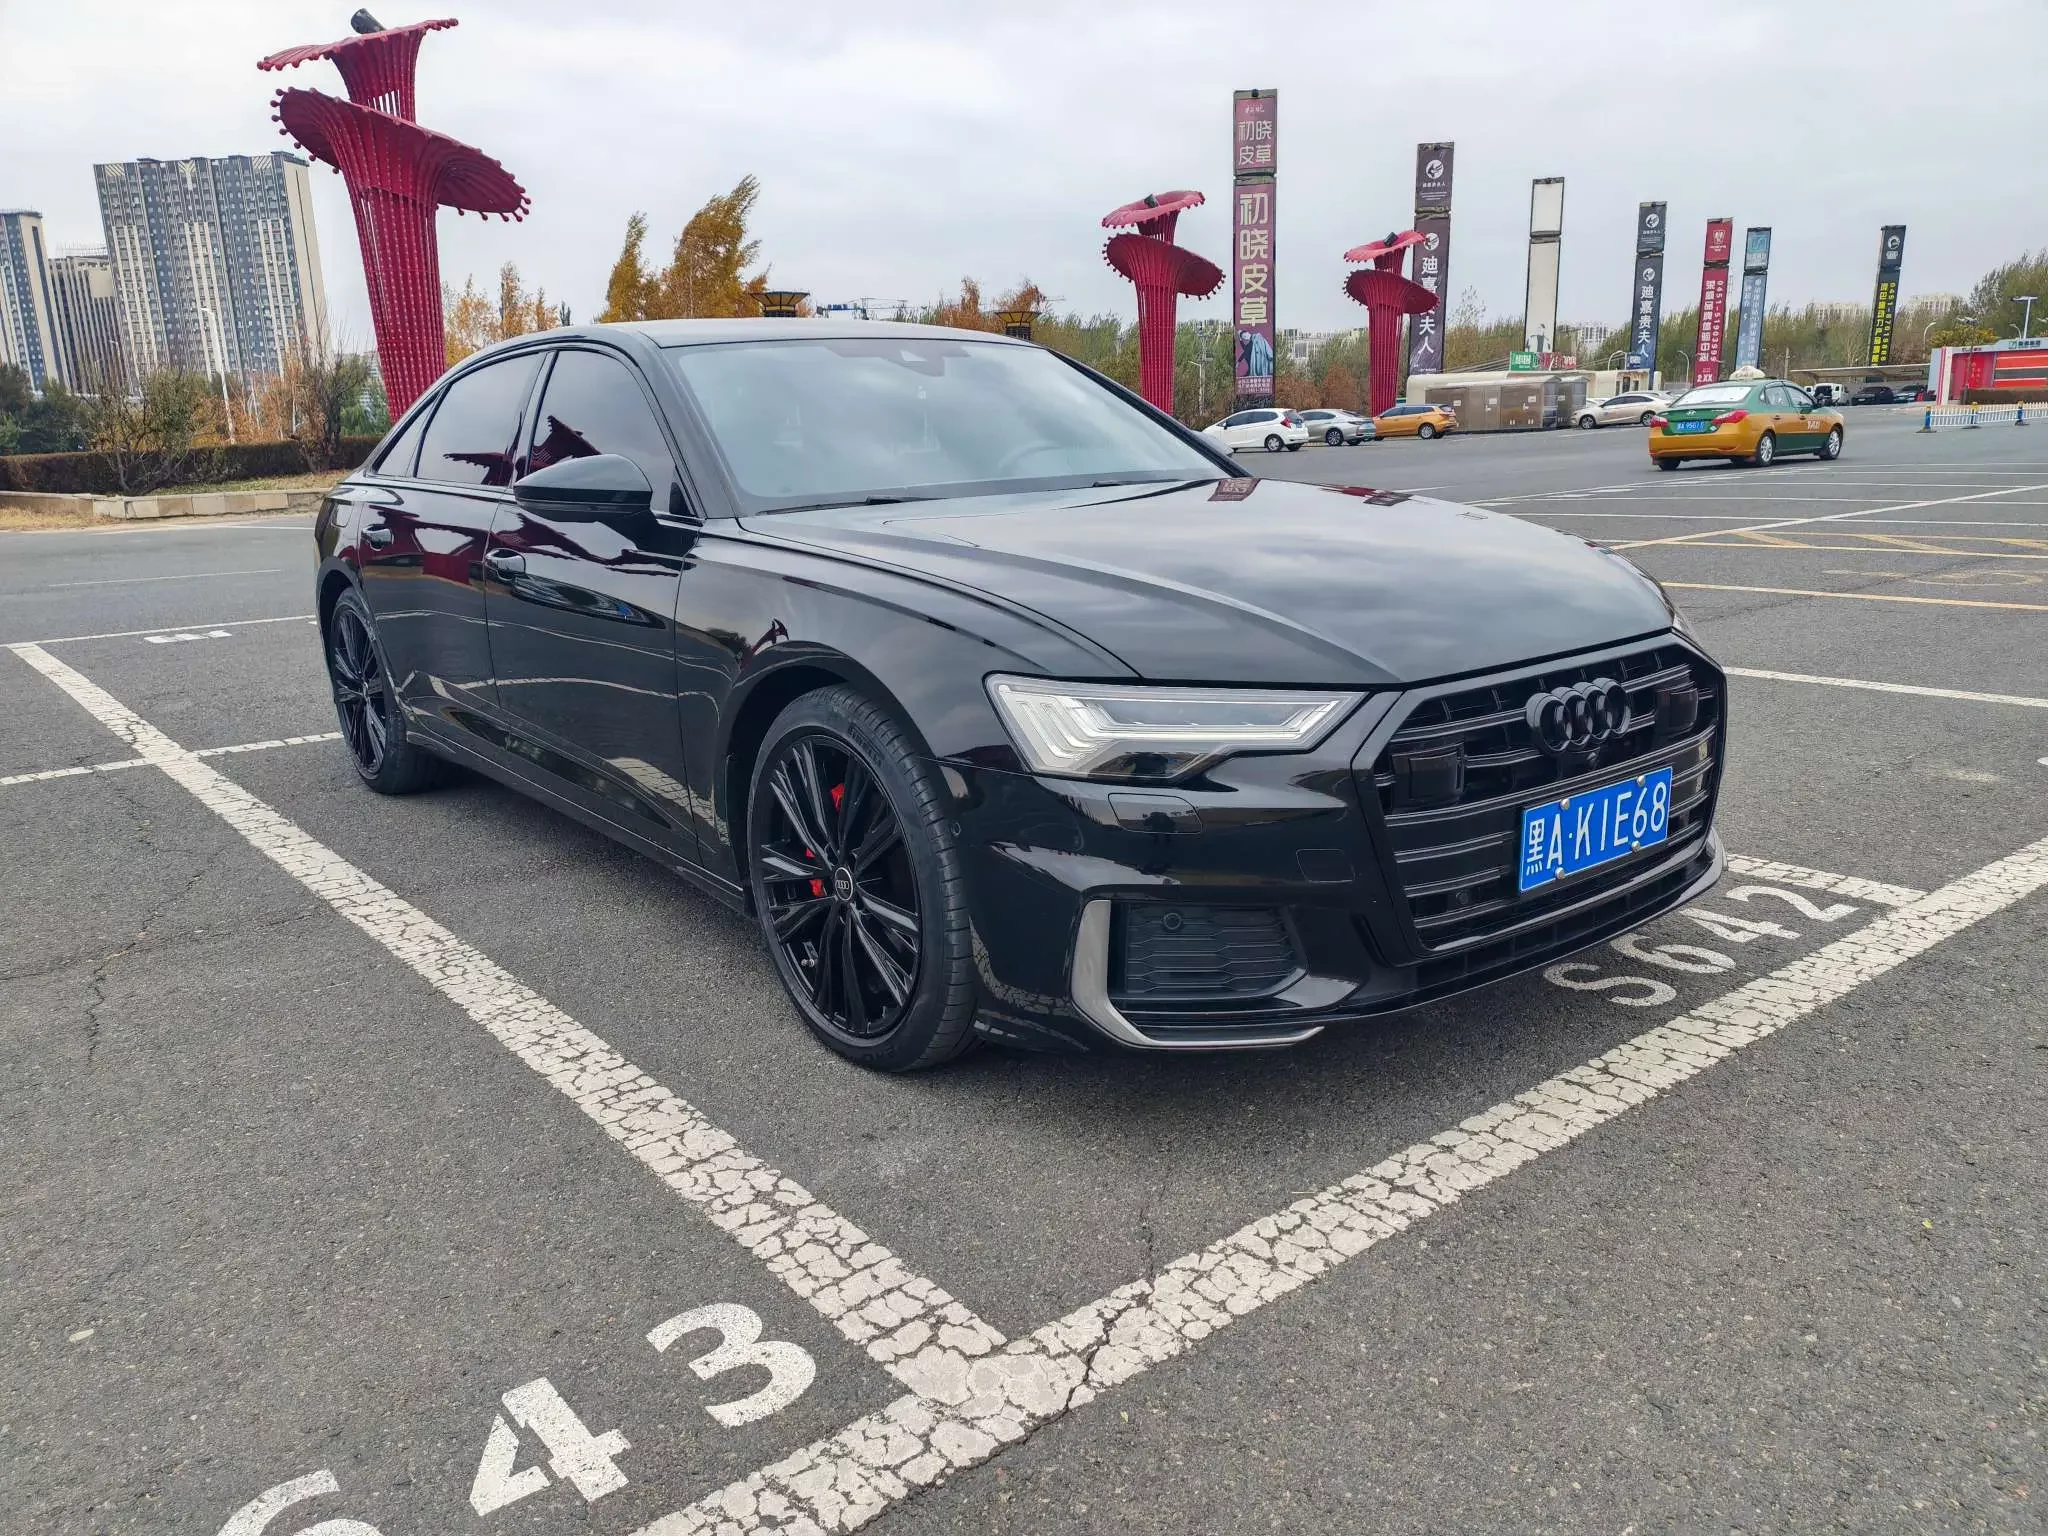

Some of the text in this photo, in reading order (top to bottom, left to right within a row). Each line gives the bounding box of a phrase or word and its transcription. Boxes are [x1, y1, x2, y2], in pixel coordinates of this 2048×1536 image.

[1238, 120, 1273, 141] 初晓
[1238, 144, 1272, 166] 皮草
[1239, 192, 1269, 327] 初晓皮草
[1543, 885, 1859, 1007] S642
